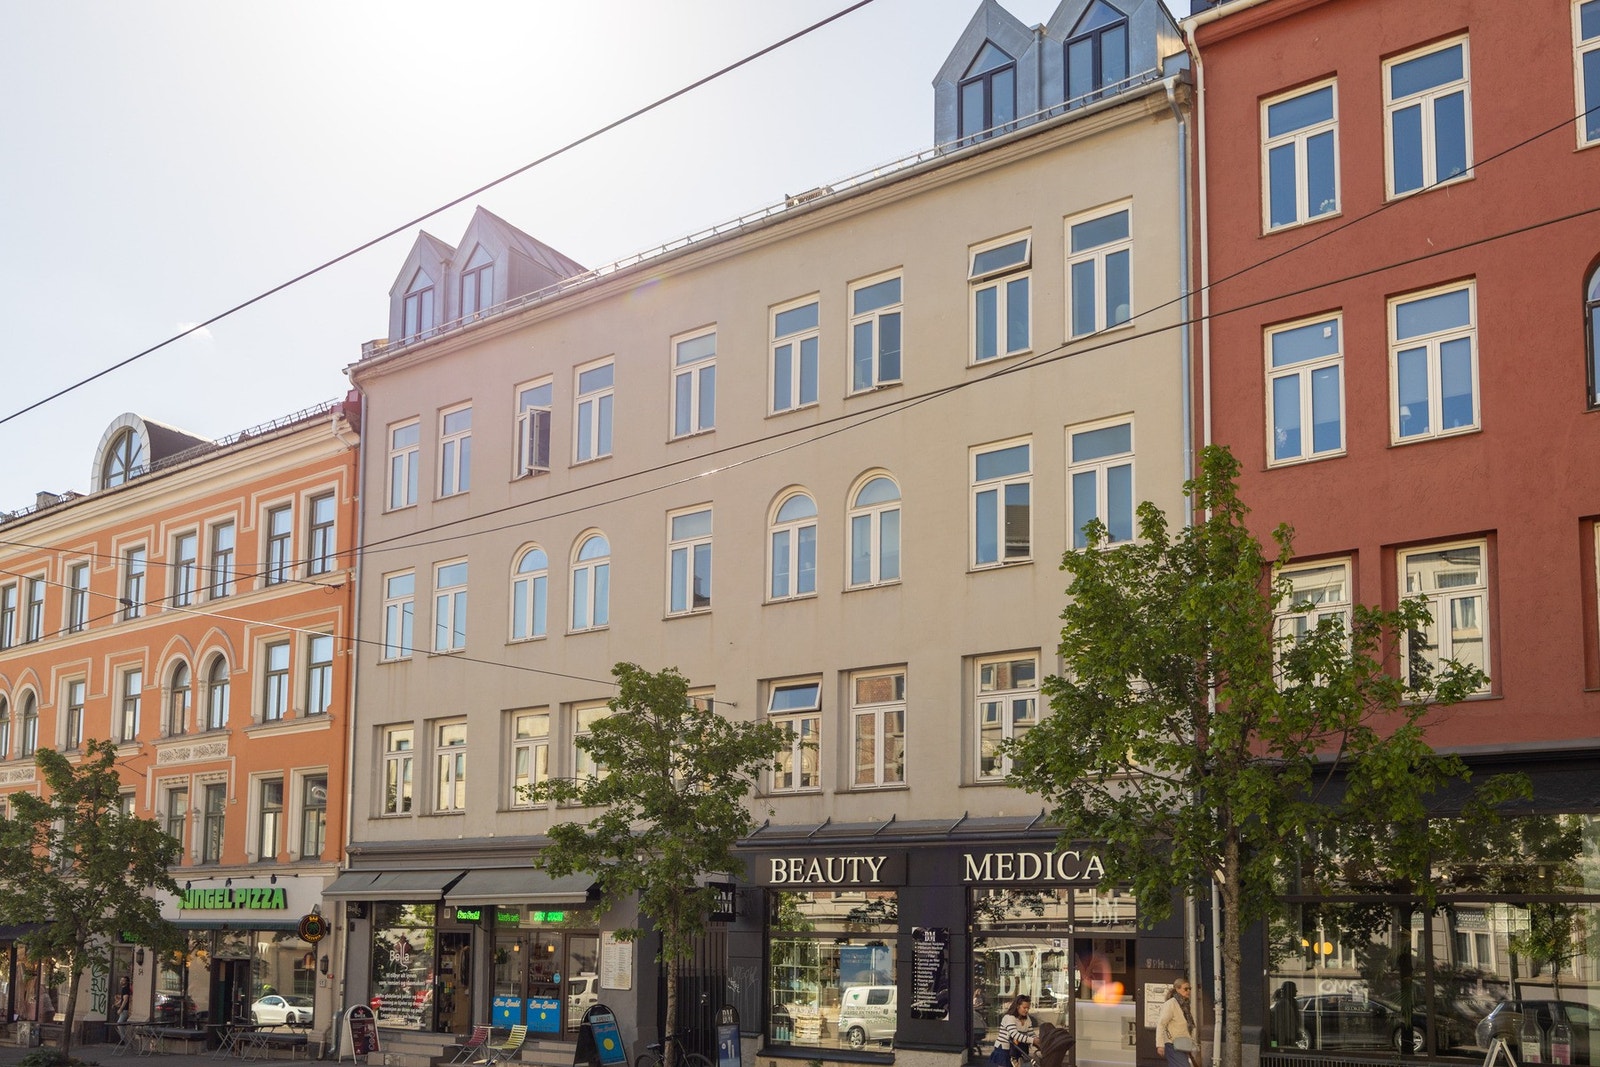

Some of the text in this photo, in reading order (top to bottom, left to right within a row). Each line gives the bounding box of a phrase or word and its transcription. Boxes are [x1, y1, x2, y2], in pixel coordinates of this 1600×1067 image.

[769, 856, 887, 883] BEAUTY
[963, 851, 1114, 882] MEDICA
[235, 888, 285, 909] PIZZA
[390, 946, 410, 964] Bella
